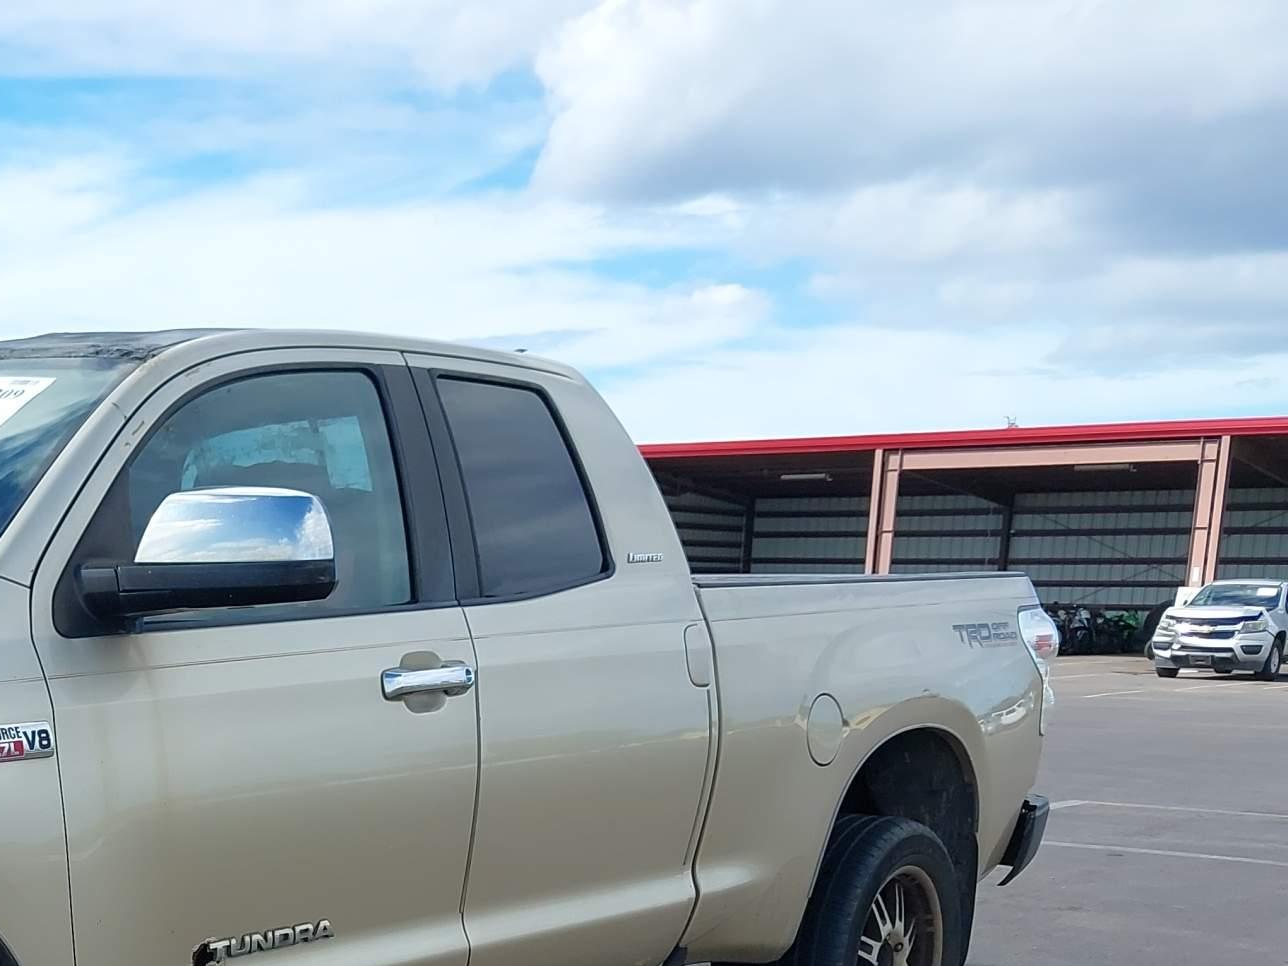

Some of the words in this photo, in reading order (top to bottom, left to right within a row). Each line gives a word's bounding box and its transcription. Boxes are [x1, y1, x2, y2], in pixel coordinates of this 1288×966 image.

[952, 623, 991, 648] TRD
[992, 632, 1017, 640] ROAD
[22, 728, 52, 751] V8
[209, 918, 335, 961] TUNDRA
